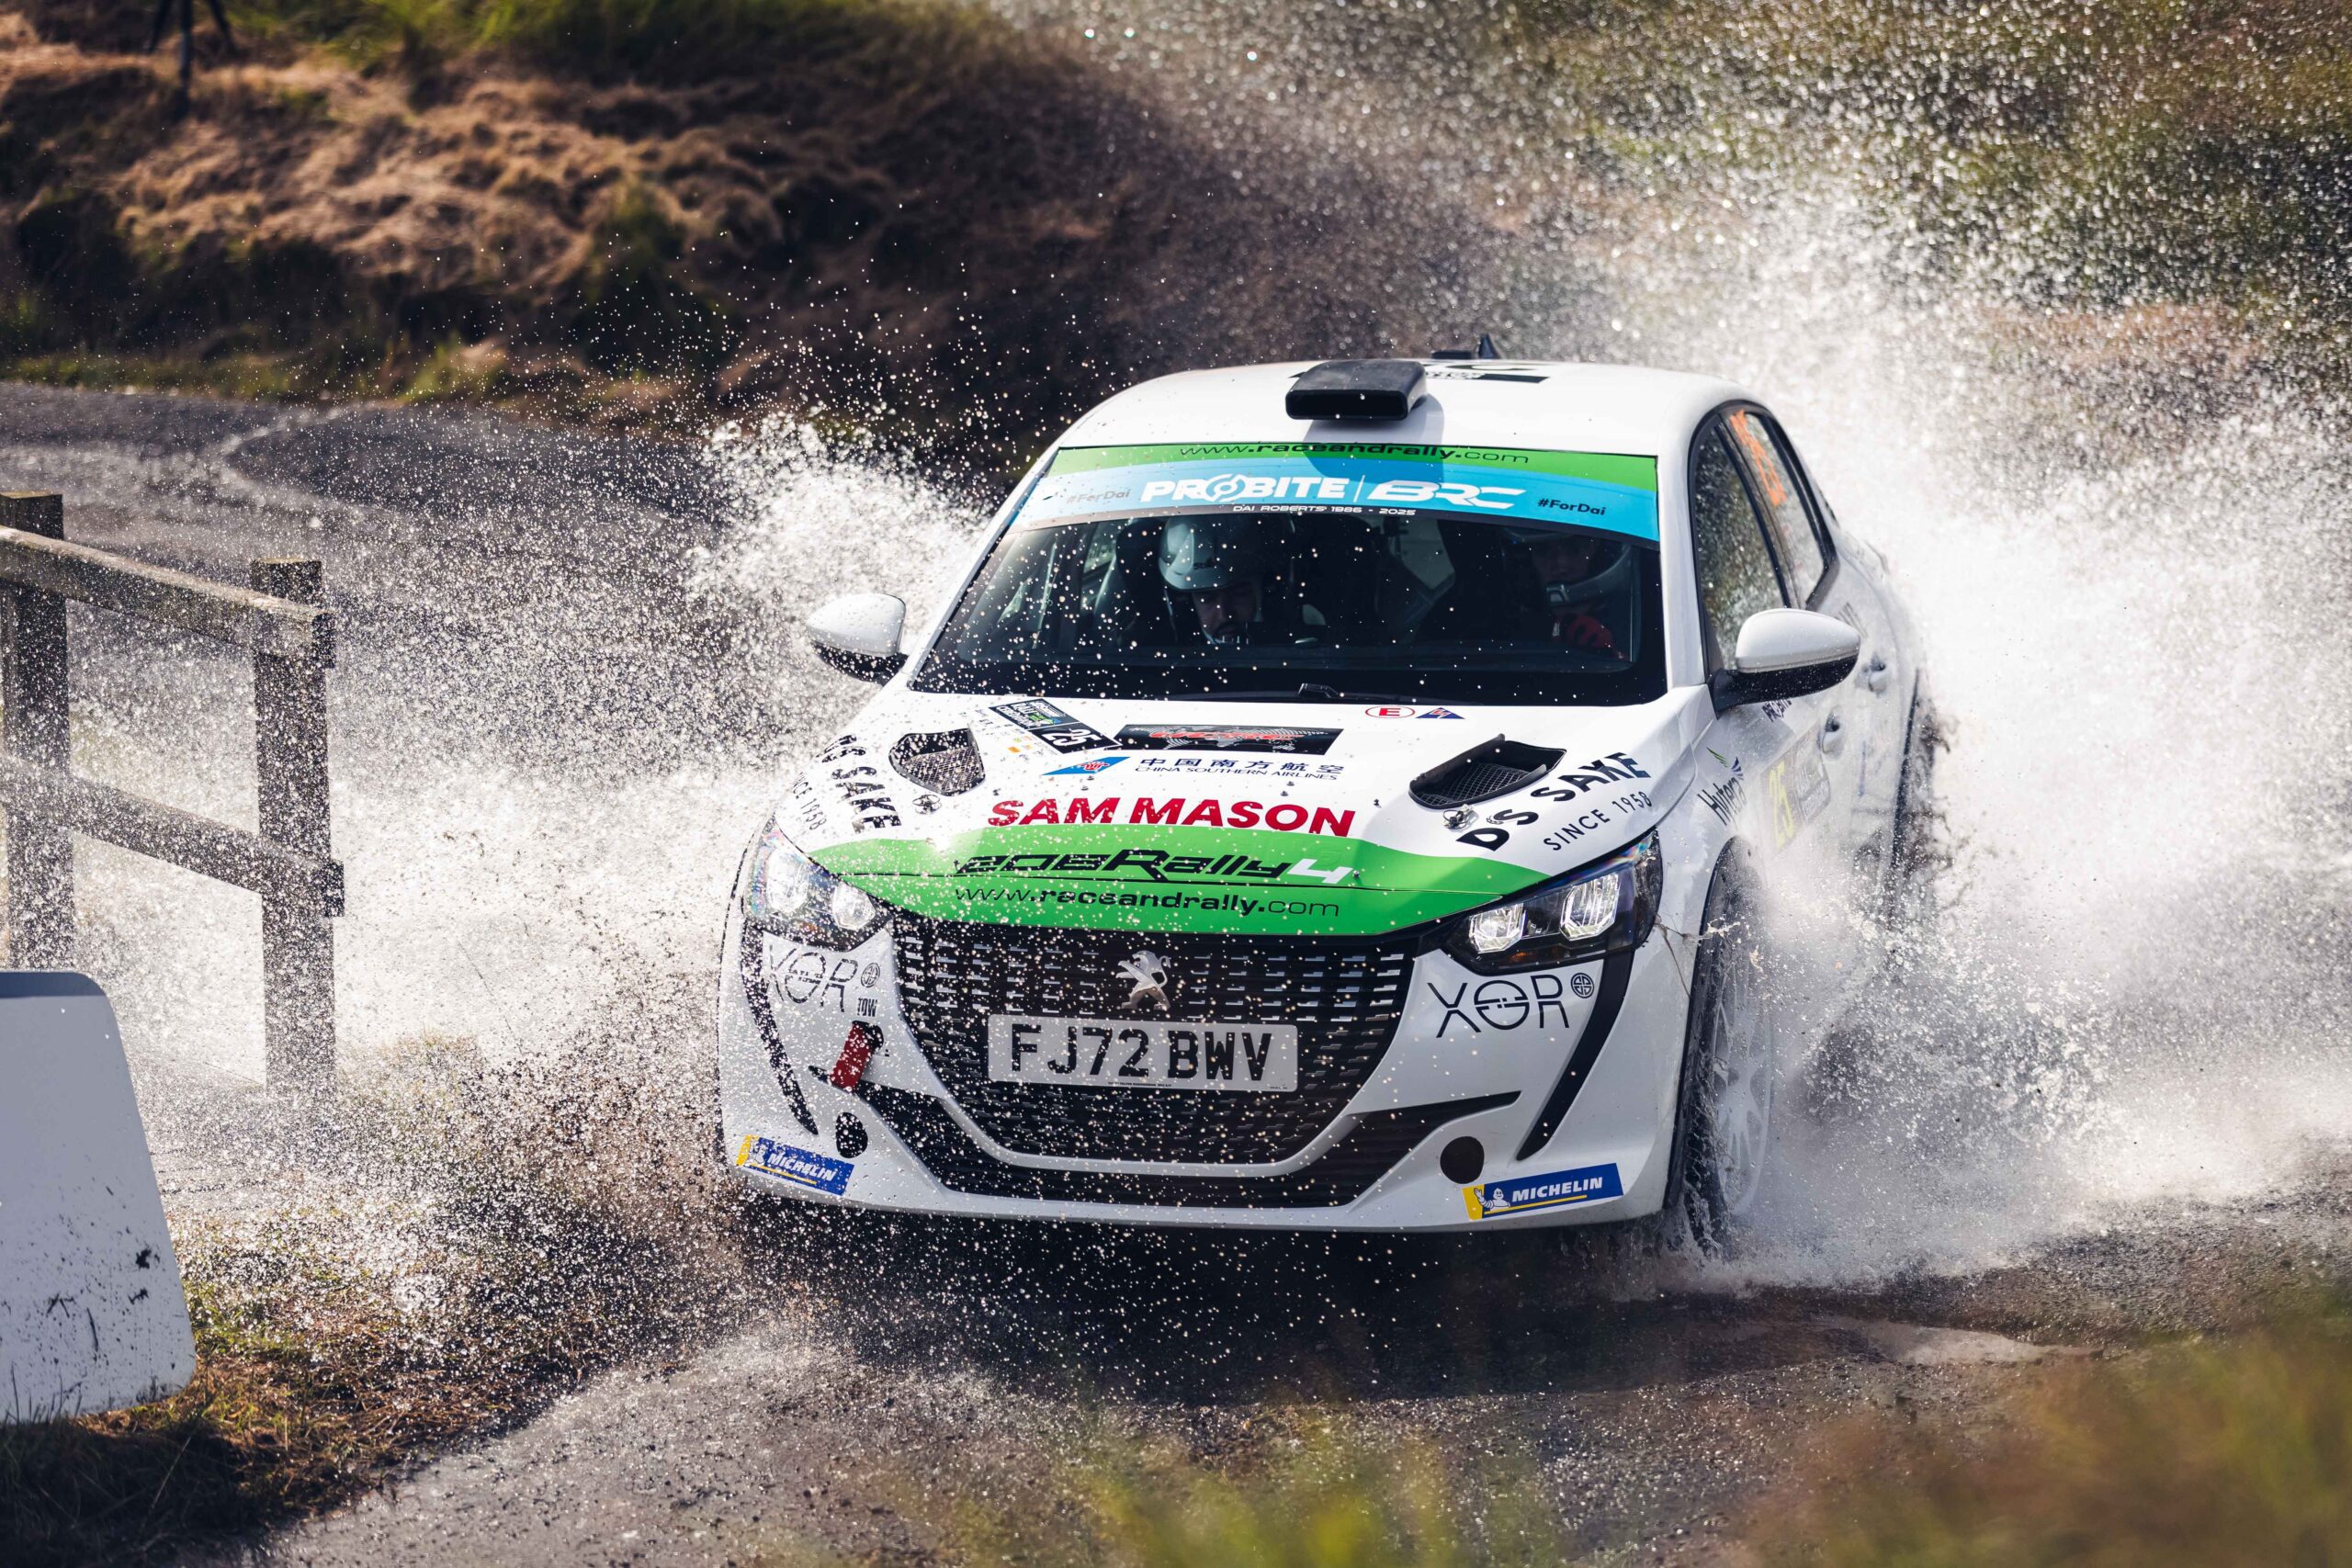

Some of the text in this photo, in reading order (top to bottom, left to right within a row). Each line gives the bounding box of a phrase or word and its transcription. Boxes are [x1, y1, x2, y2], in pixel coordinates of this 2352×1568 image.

[1140, 473, 1527, 509] PROBITE BRC
[1331, 506, 1363, 514] 1986
[1378, 507, 1417, 515] 2025
[1537, 498, 1607, 516] #ForDai
[1041, 728, 1102, 747] 25
[1138, 758, 1345, 774] 中国南方航空
[1187, 767, 1268, 776] SOUTHERN
[1271, 770, 1339, 781] AIRLINES
[800, 797, 828, 830] 1958
[831, 766, 902, 834] SAKE
[1455, 751, 1652, 852] DS SAKE
[988, 797, 1356, 838] SAM MASON
[1543, 790, 1653, 852] SINCE 1958
[955, 887, 1340, 917] www.raceandrally.com
[856, 998, 878, 1017] TOW
[1011, 1022, 1272, 1082] FJ72 BWV
[766, 1152, 838, 1182] MICHELIN
[1511, 1176, 1603, 1203] MICHELIN
